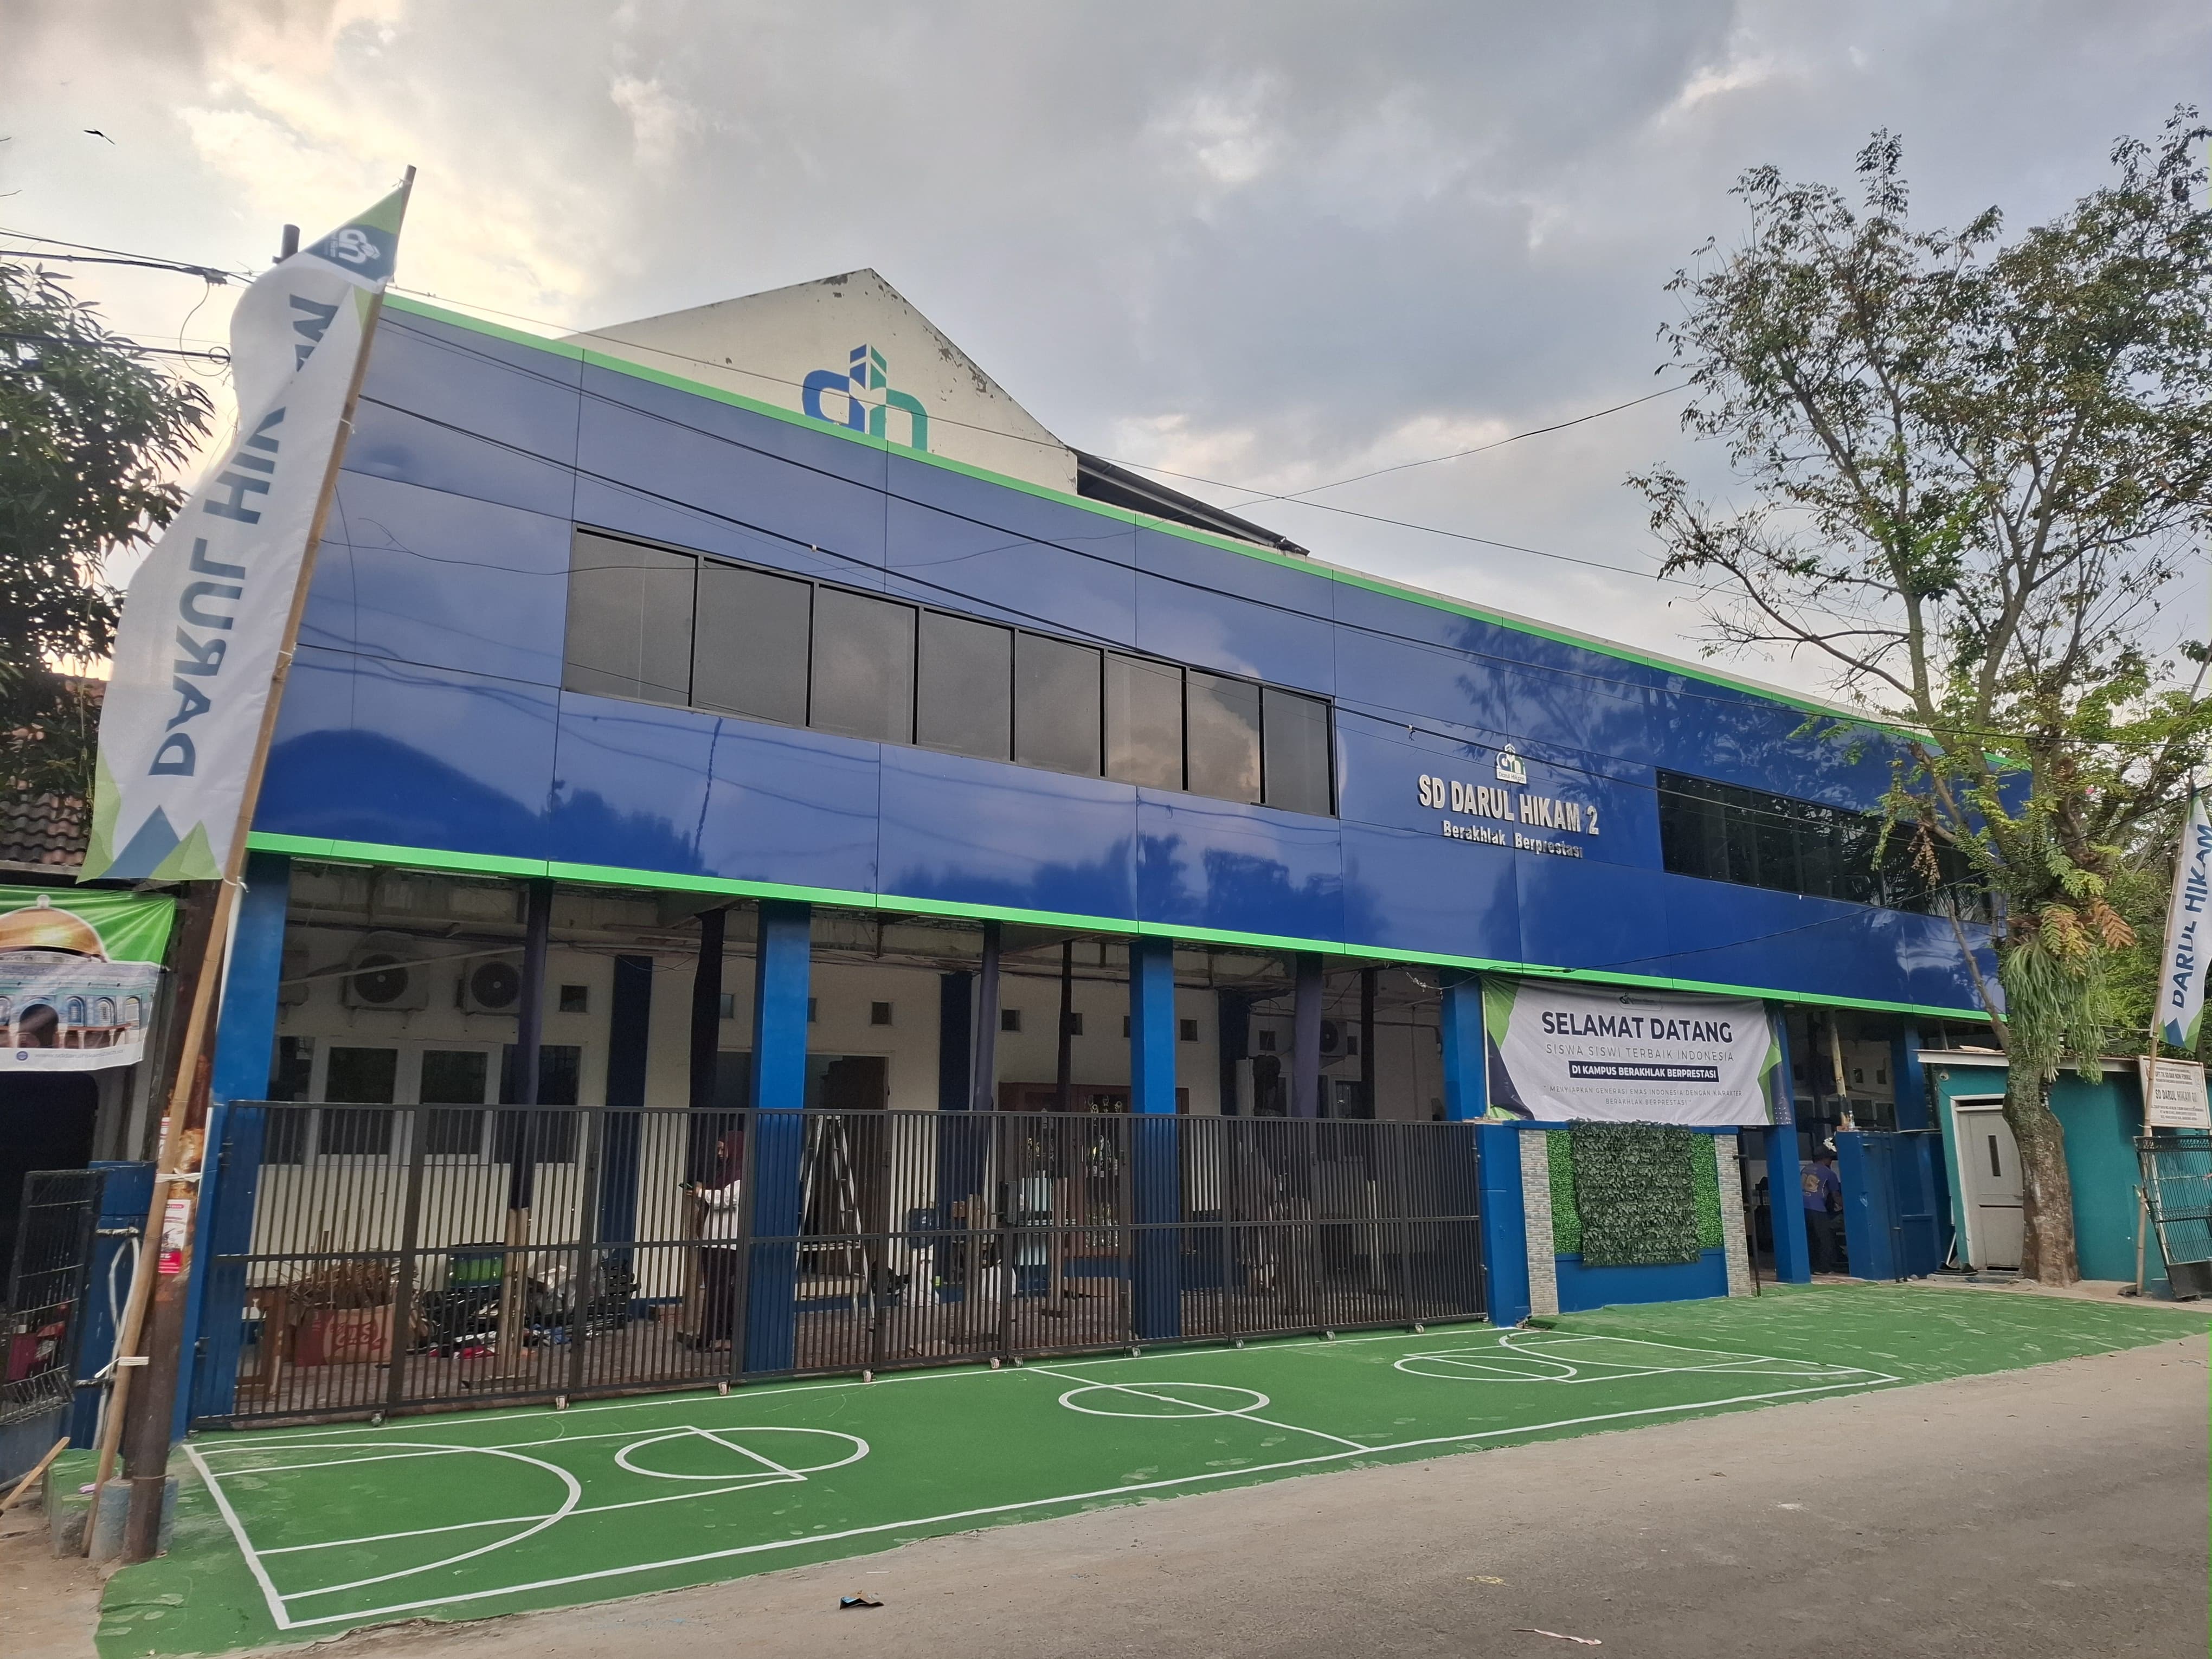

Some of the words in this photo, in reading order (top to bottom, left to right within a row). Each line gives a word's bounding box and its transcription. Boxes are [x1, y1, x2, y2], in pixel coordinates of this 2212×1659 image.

[1418, 774, 1445, 808] SD
[1450, 780, 1514, 821] DARUL
[1520, 794, 1581, 832] HIKAM
[1586, 805, 1599, 835] 2
[1442, 820, 1506, 846] Berakhlak
[1515, 832, 1583, 858] Berprestasi
[2172, 921, 2197, 1008] DARUL
[2185, 824, 2212, 913] HIKAM
[1541, 1011, 1644, 1039] SELAMAT
[1651, 1018, 1733, 1043] DATANG
[1546, 1043, 1584, 1056] SISWA
[1589, 1046, 1621, 1058] SISWI
[1625, 1047, 1673, 1060] TERBAIK
[1677, 1050, 1734, 1062] INDONESIA
[1572, 1065, 1581, 1073] DI
[1583, 1065, 1617, 1076] KAMPUS
[1618, 1066, 1666, 1078] BERAKHLAK
[1667, 1069, 1716, 1079] BERPRESTASI
[2155, 1089, 2162, 1099] SD
[2162, 1089, 2177, 1101] DARUL
